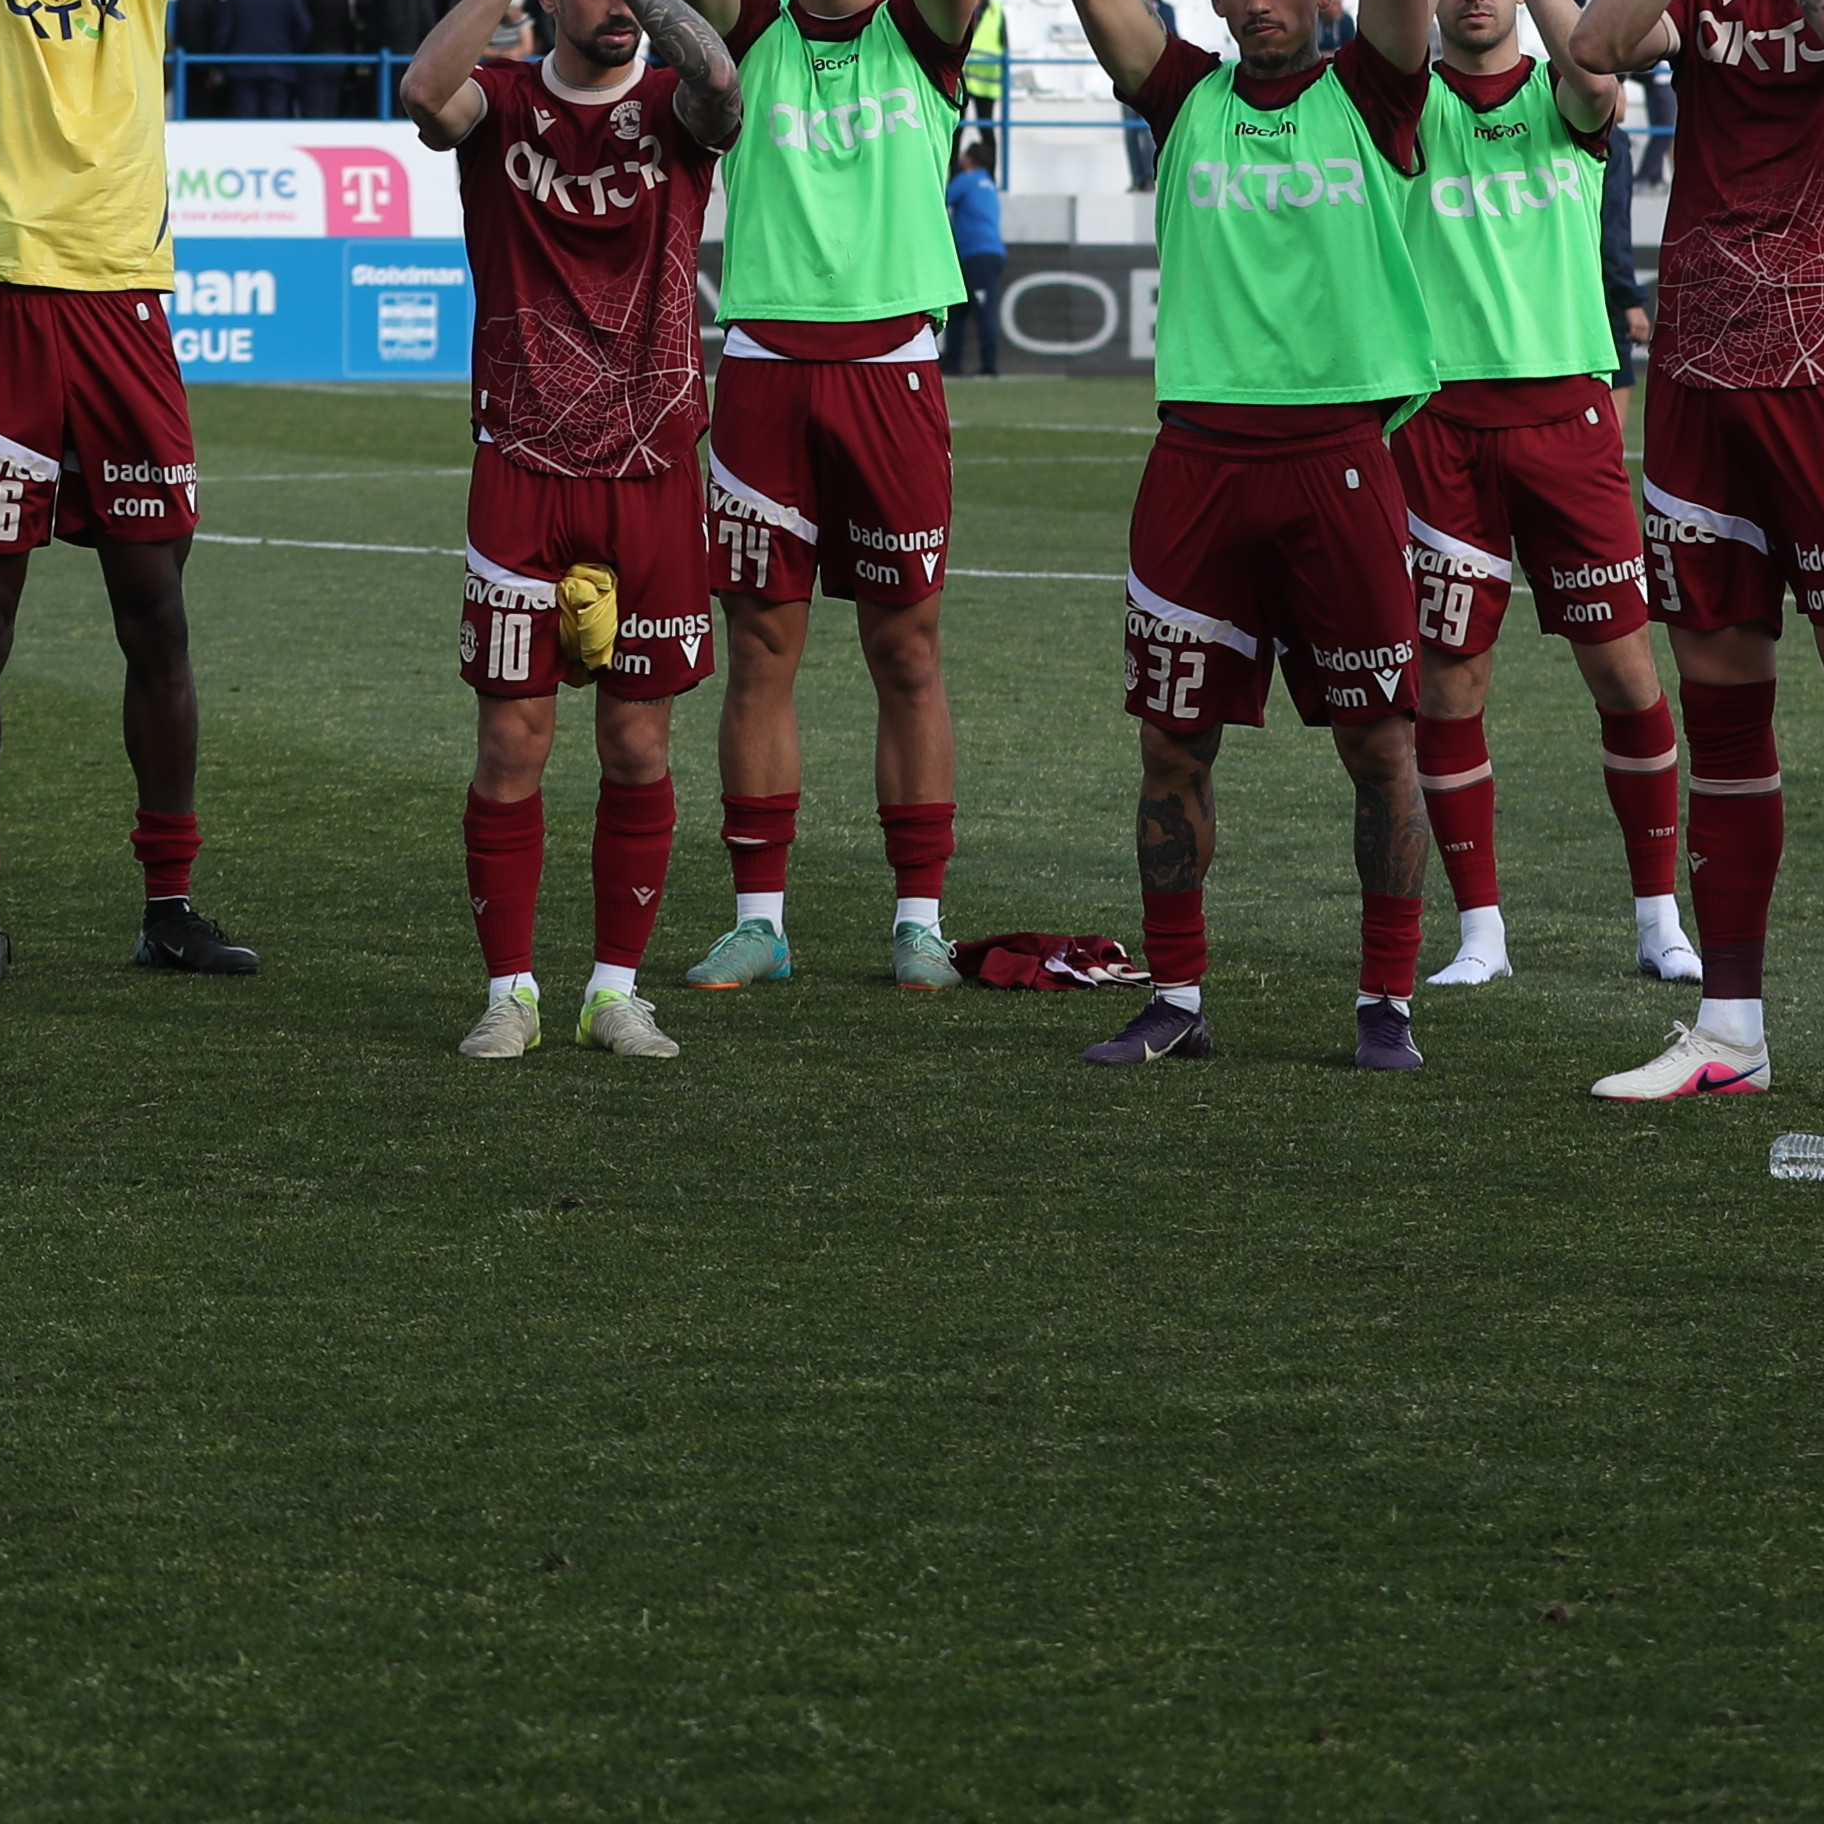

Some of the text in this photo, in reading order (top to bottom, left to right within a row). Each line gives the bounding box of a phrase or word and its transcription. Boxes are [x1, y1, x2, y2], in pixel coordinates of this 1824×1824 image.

[167, 168, 297, 200] MOTE
[107, 497, 165, 518] .com
[718, 519, 770, 579] 74
[848, 519, 945, 552] badounas
[620, 613, 711, 639] dounas
[1418, 575, 1474, 648] 29
[1563, 601, 1613, 623] .com
[487, 610, 533, 681] 10
[1146, 643, 1206, 719] 32
